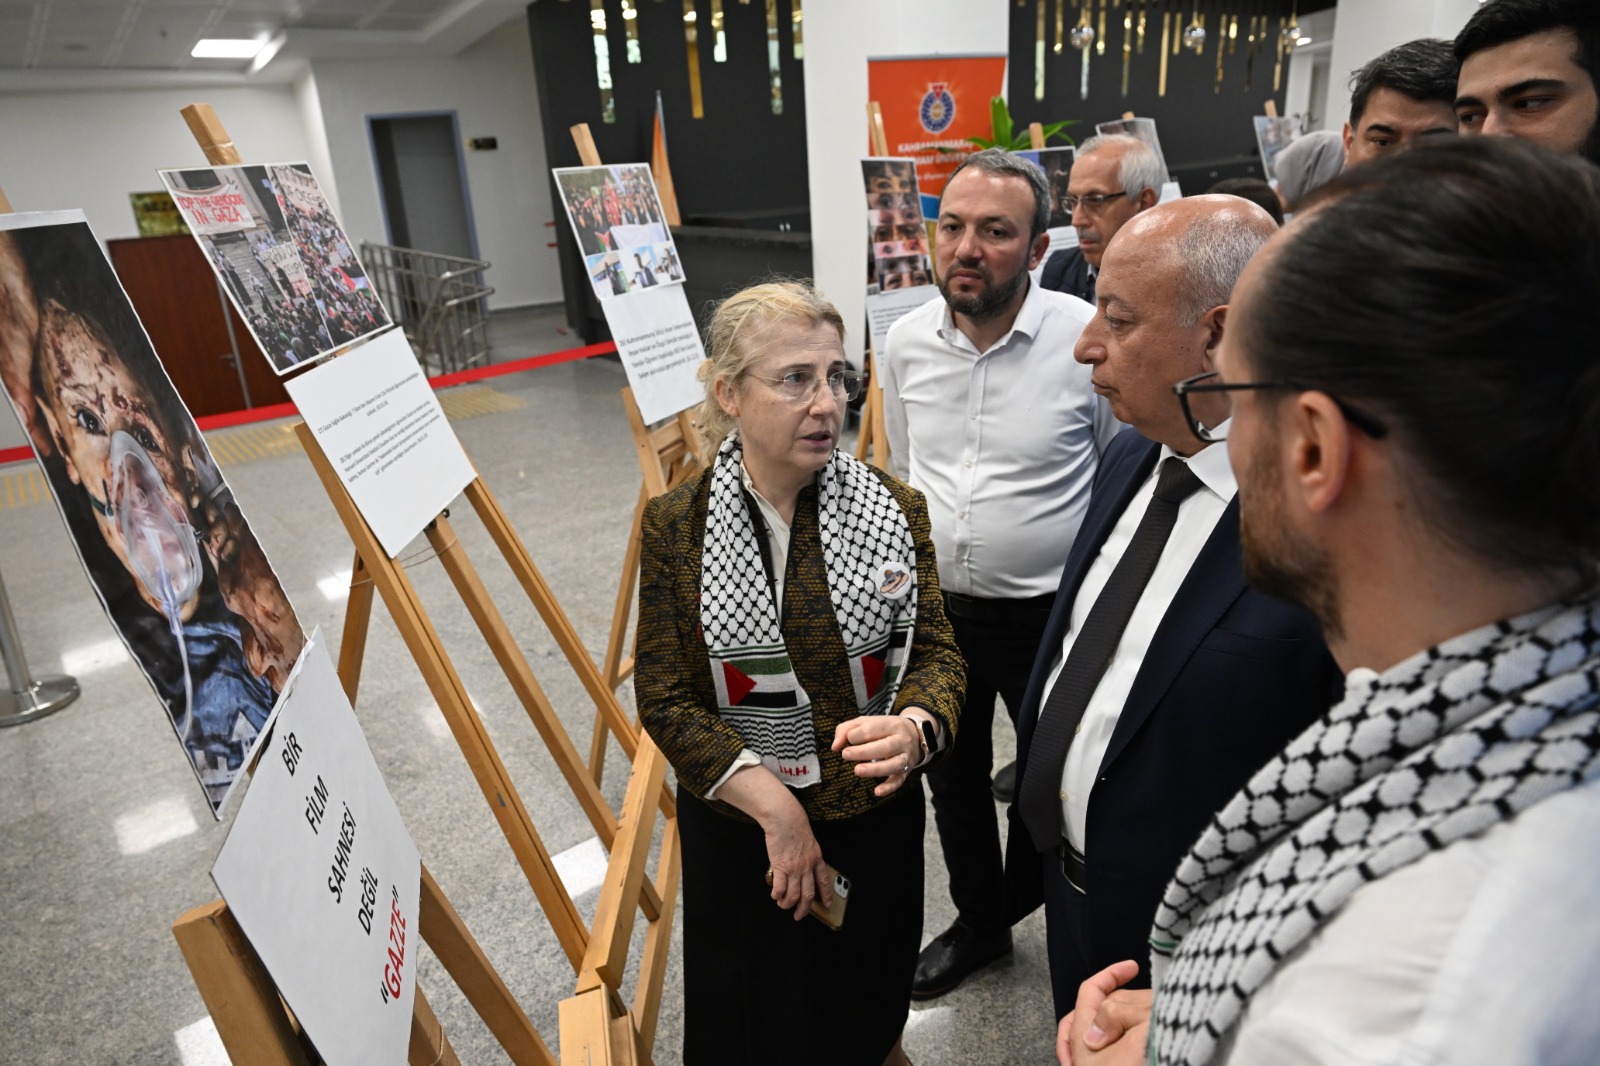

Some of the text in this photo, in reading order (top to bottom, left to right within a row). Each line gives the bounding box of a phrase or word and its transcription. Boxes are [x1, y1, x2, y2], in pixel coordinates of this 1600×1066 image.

[192, 205, 245, 224] IN GAZA
[193, 196, 212, 208] THE
[210, 193, 245, 207] GENOCIDE
[281, 732, 303, 777] BİR
[305, 774, 329, 835] FİLM
[327, 801, 357, 904] SAHNESİ
[358, 867, 378, 936] DEĞİL
